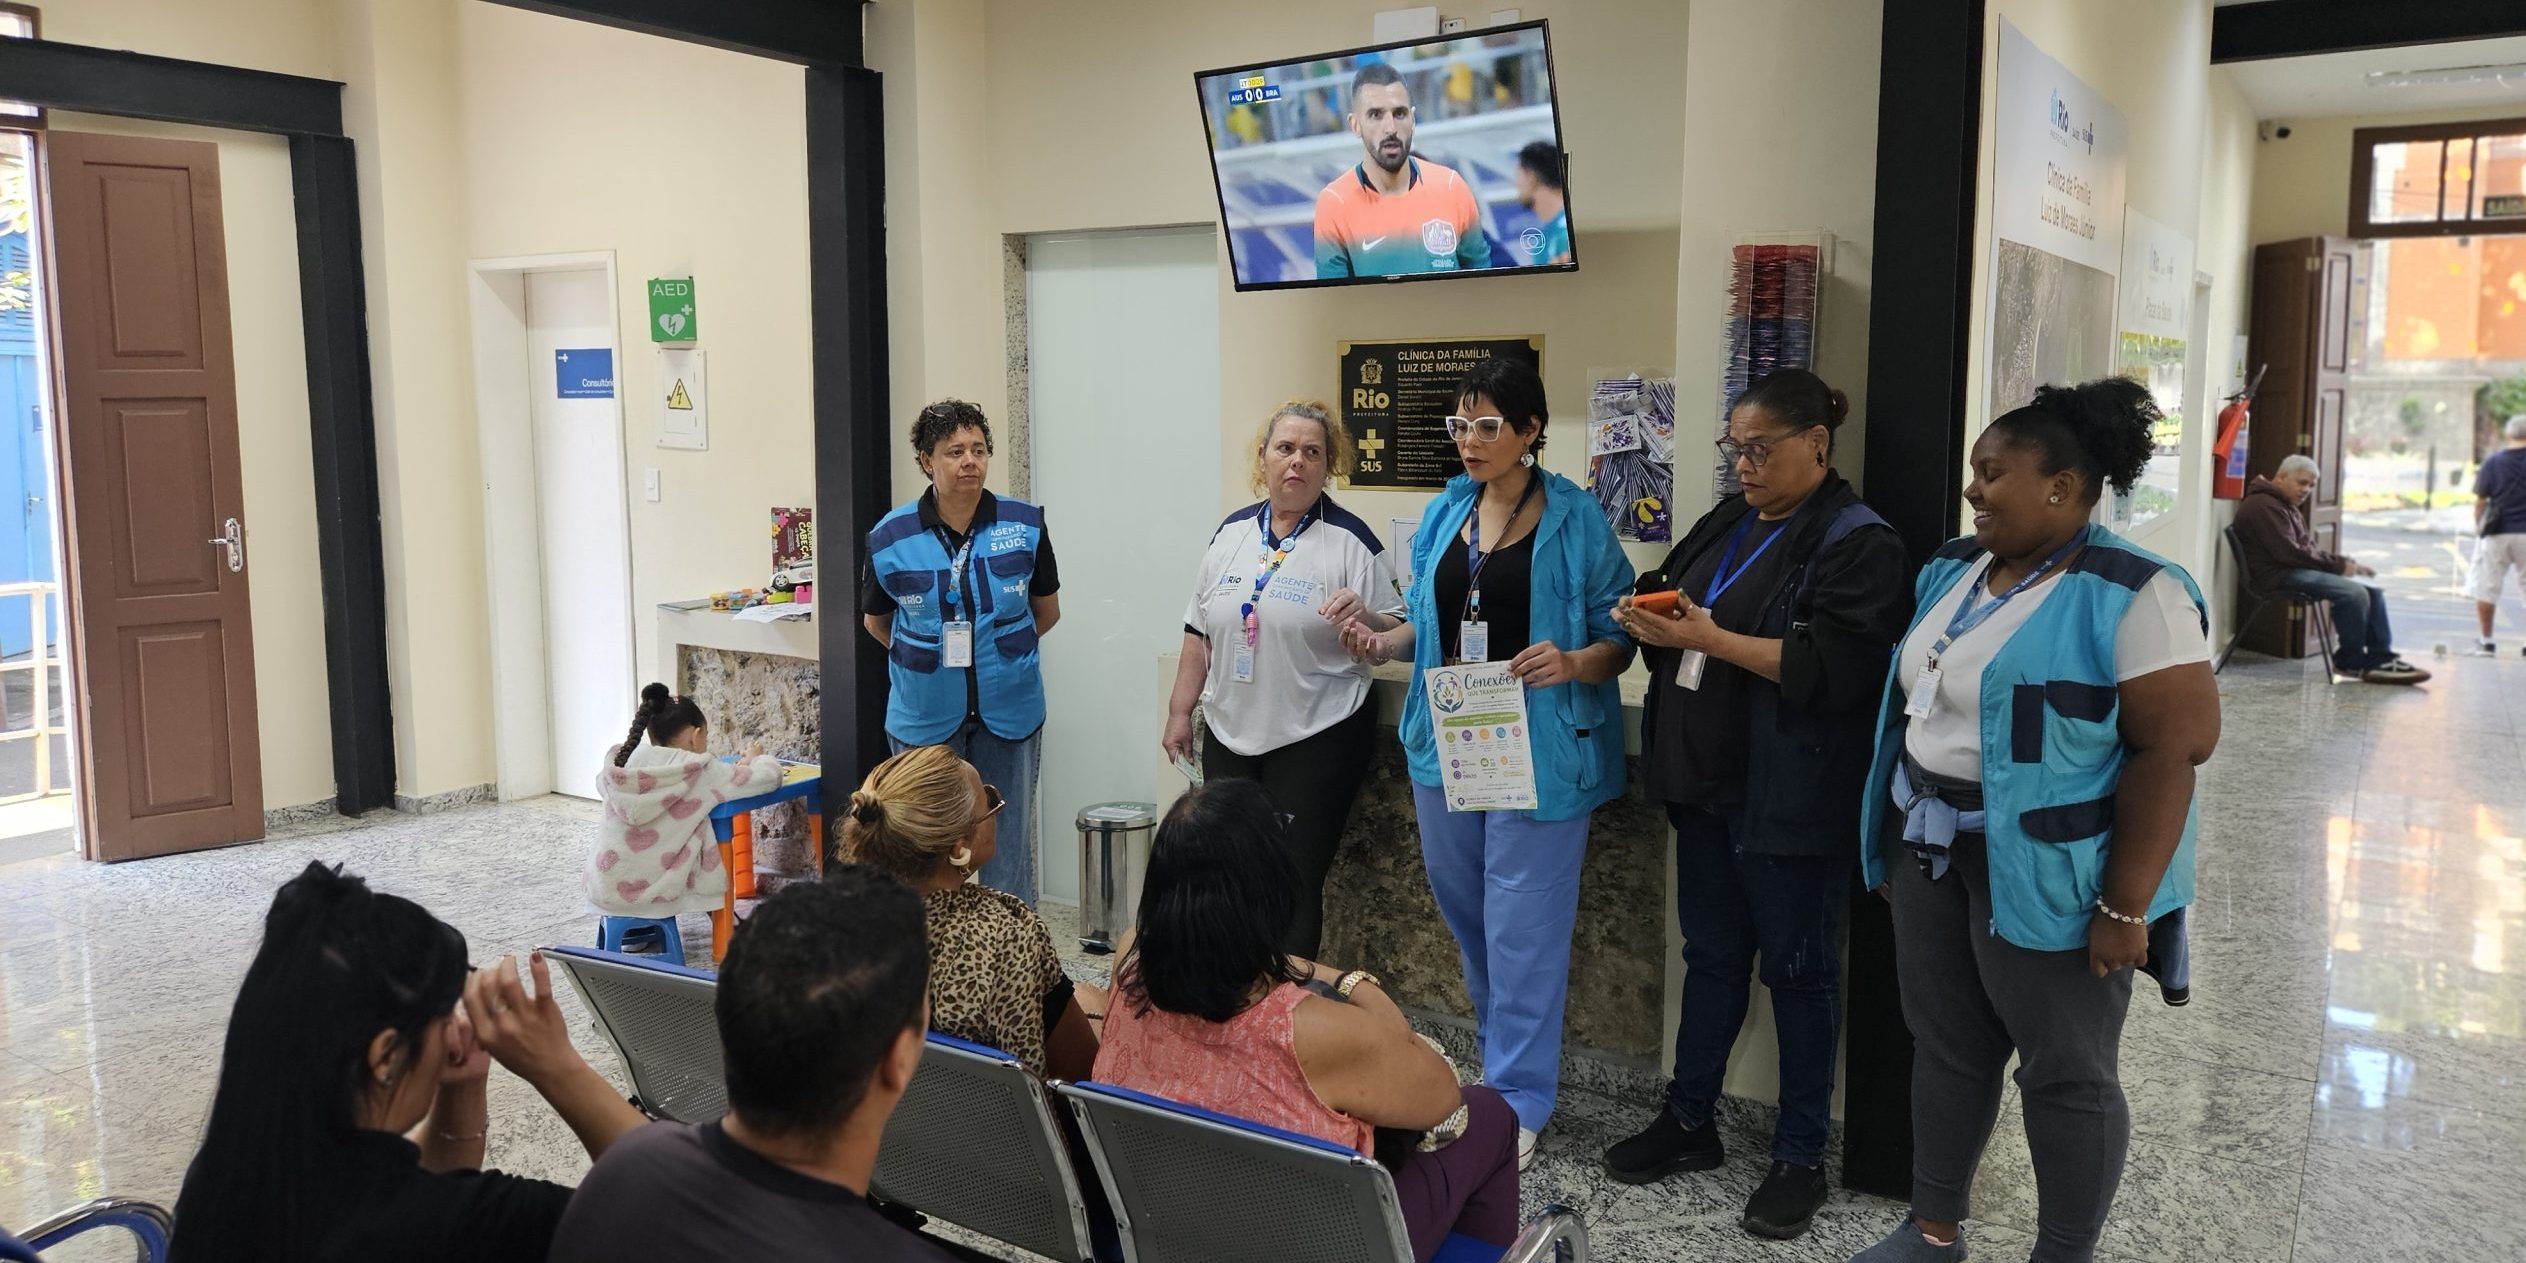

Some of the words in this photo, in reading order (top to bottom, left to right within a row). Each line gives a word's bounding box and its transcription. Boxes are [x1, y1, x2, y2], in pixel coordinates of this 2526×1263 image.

[1231, 94, 1243, 102] AUS
[1245, 90, 1252, 102] 0
[1255, 88, 1264, 101] 0
[2058, 98, 2069, 133] Rio
[653, 283, 688, 296] AED
[1398, 350, 1435, 361] CLÍNICA
[1437, 351, 1451, 360] DA
[1453, 347, 1491, 360] FAMÍLIA
[1398, 363, 1419, 373] LUIZ
[1421, 362, 1434, 372] DE
[1436, 362, 1476, 372] MORAES
[1353, 388, 1390, 409] Rio
[1360, 460, 1382, 472] SUS
[990, 525, 1027, 537] AGENTE
[799, 522, 810, 560] CABEÇA
[990, 538, 1027, 551] SAÚDE
[1228, 576, 1242, 584] Rio
[1274, 577, 1314, 590] AGENTE
[1268, 590, 1310, 605] SAÚDE
[1464, 672, 1517, 690] Conexões
